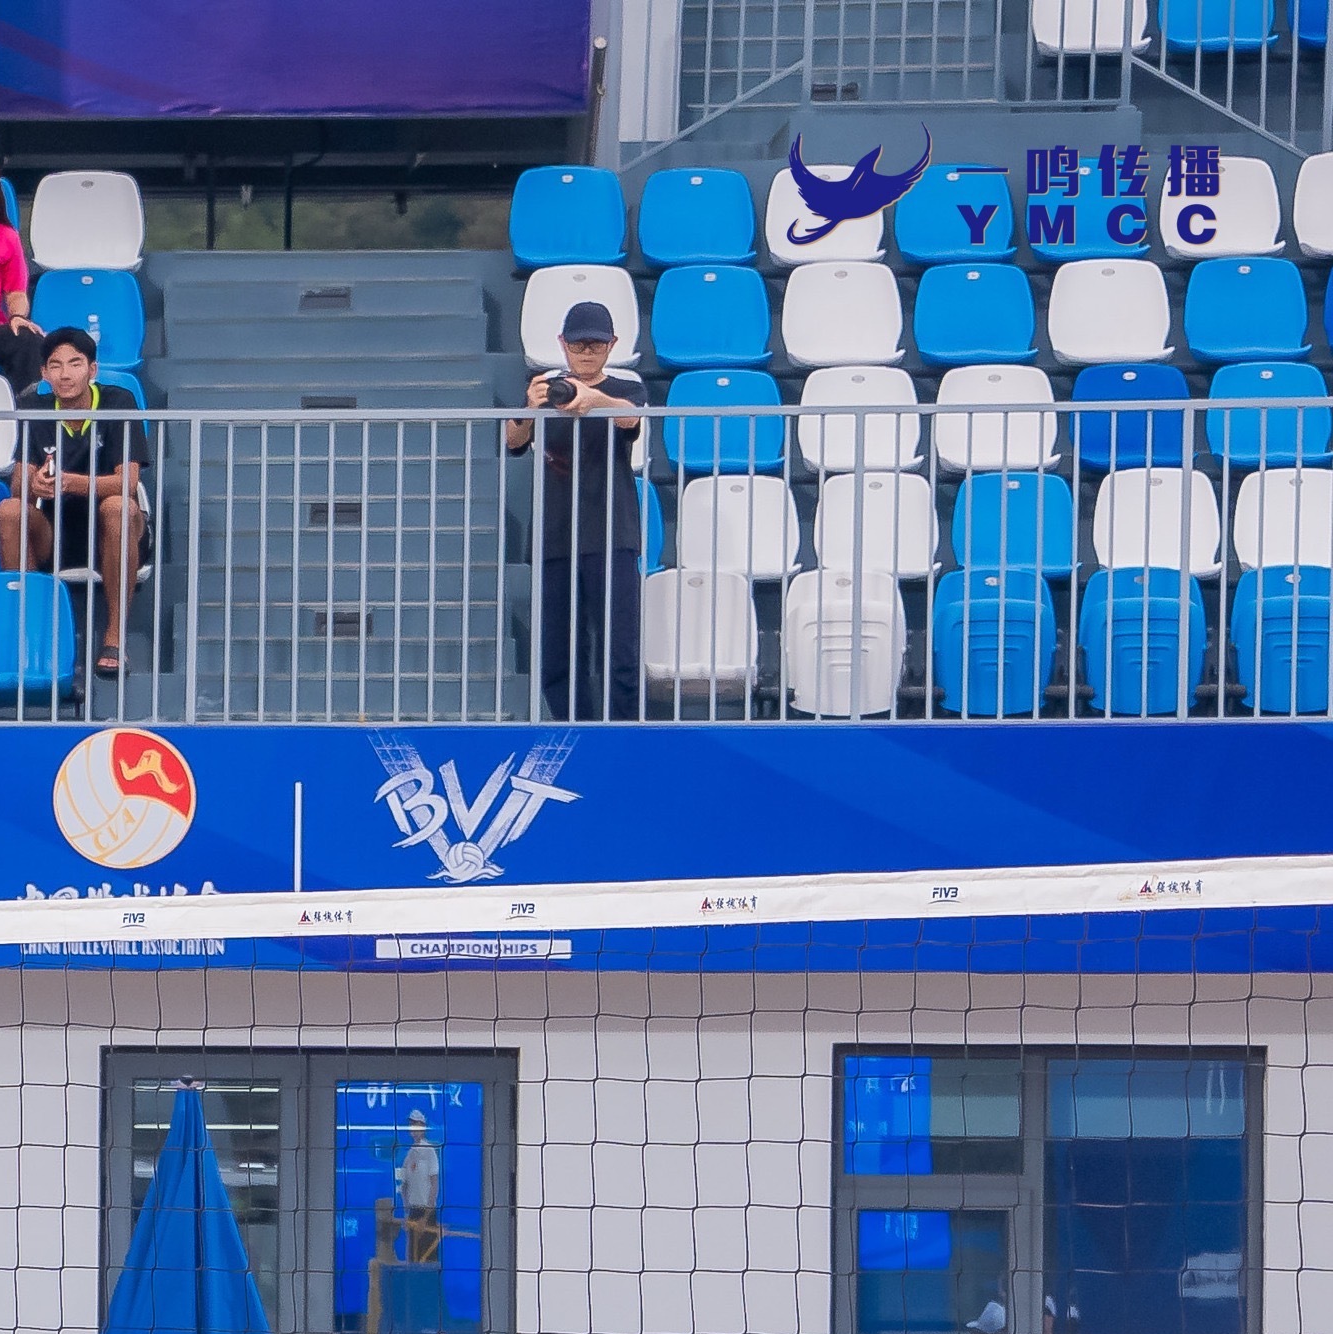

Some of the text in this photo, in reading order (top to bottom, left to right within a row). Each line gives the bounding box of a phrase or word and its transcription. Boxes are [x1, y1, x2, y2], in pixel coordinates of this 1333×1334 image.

[93, 811, 136, 850] CVA
[932, 887, 958, 898] FIVB
[511, 903, 535, 913] FIVB
[123, 913, 145, 923] FIVB
[410, 941, 539, 956] CHAMPIONSHIPS
